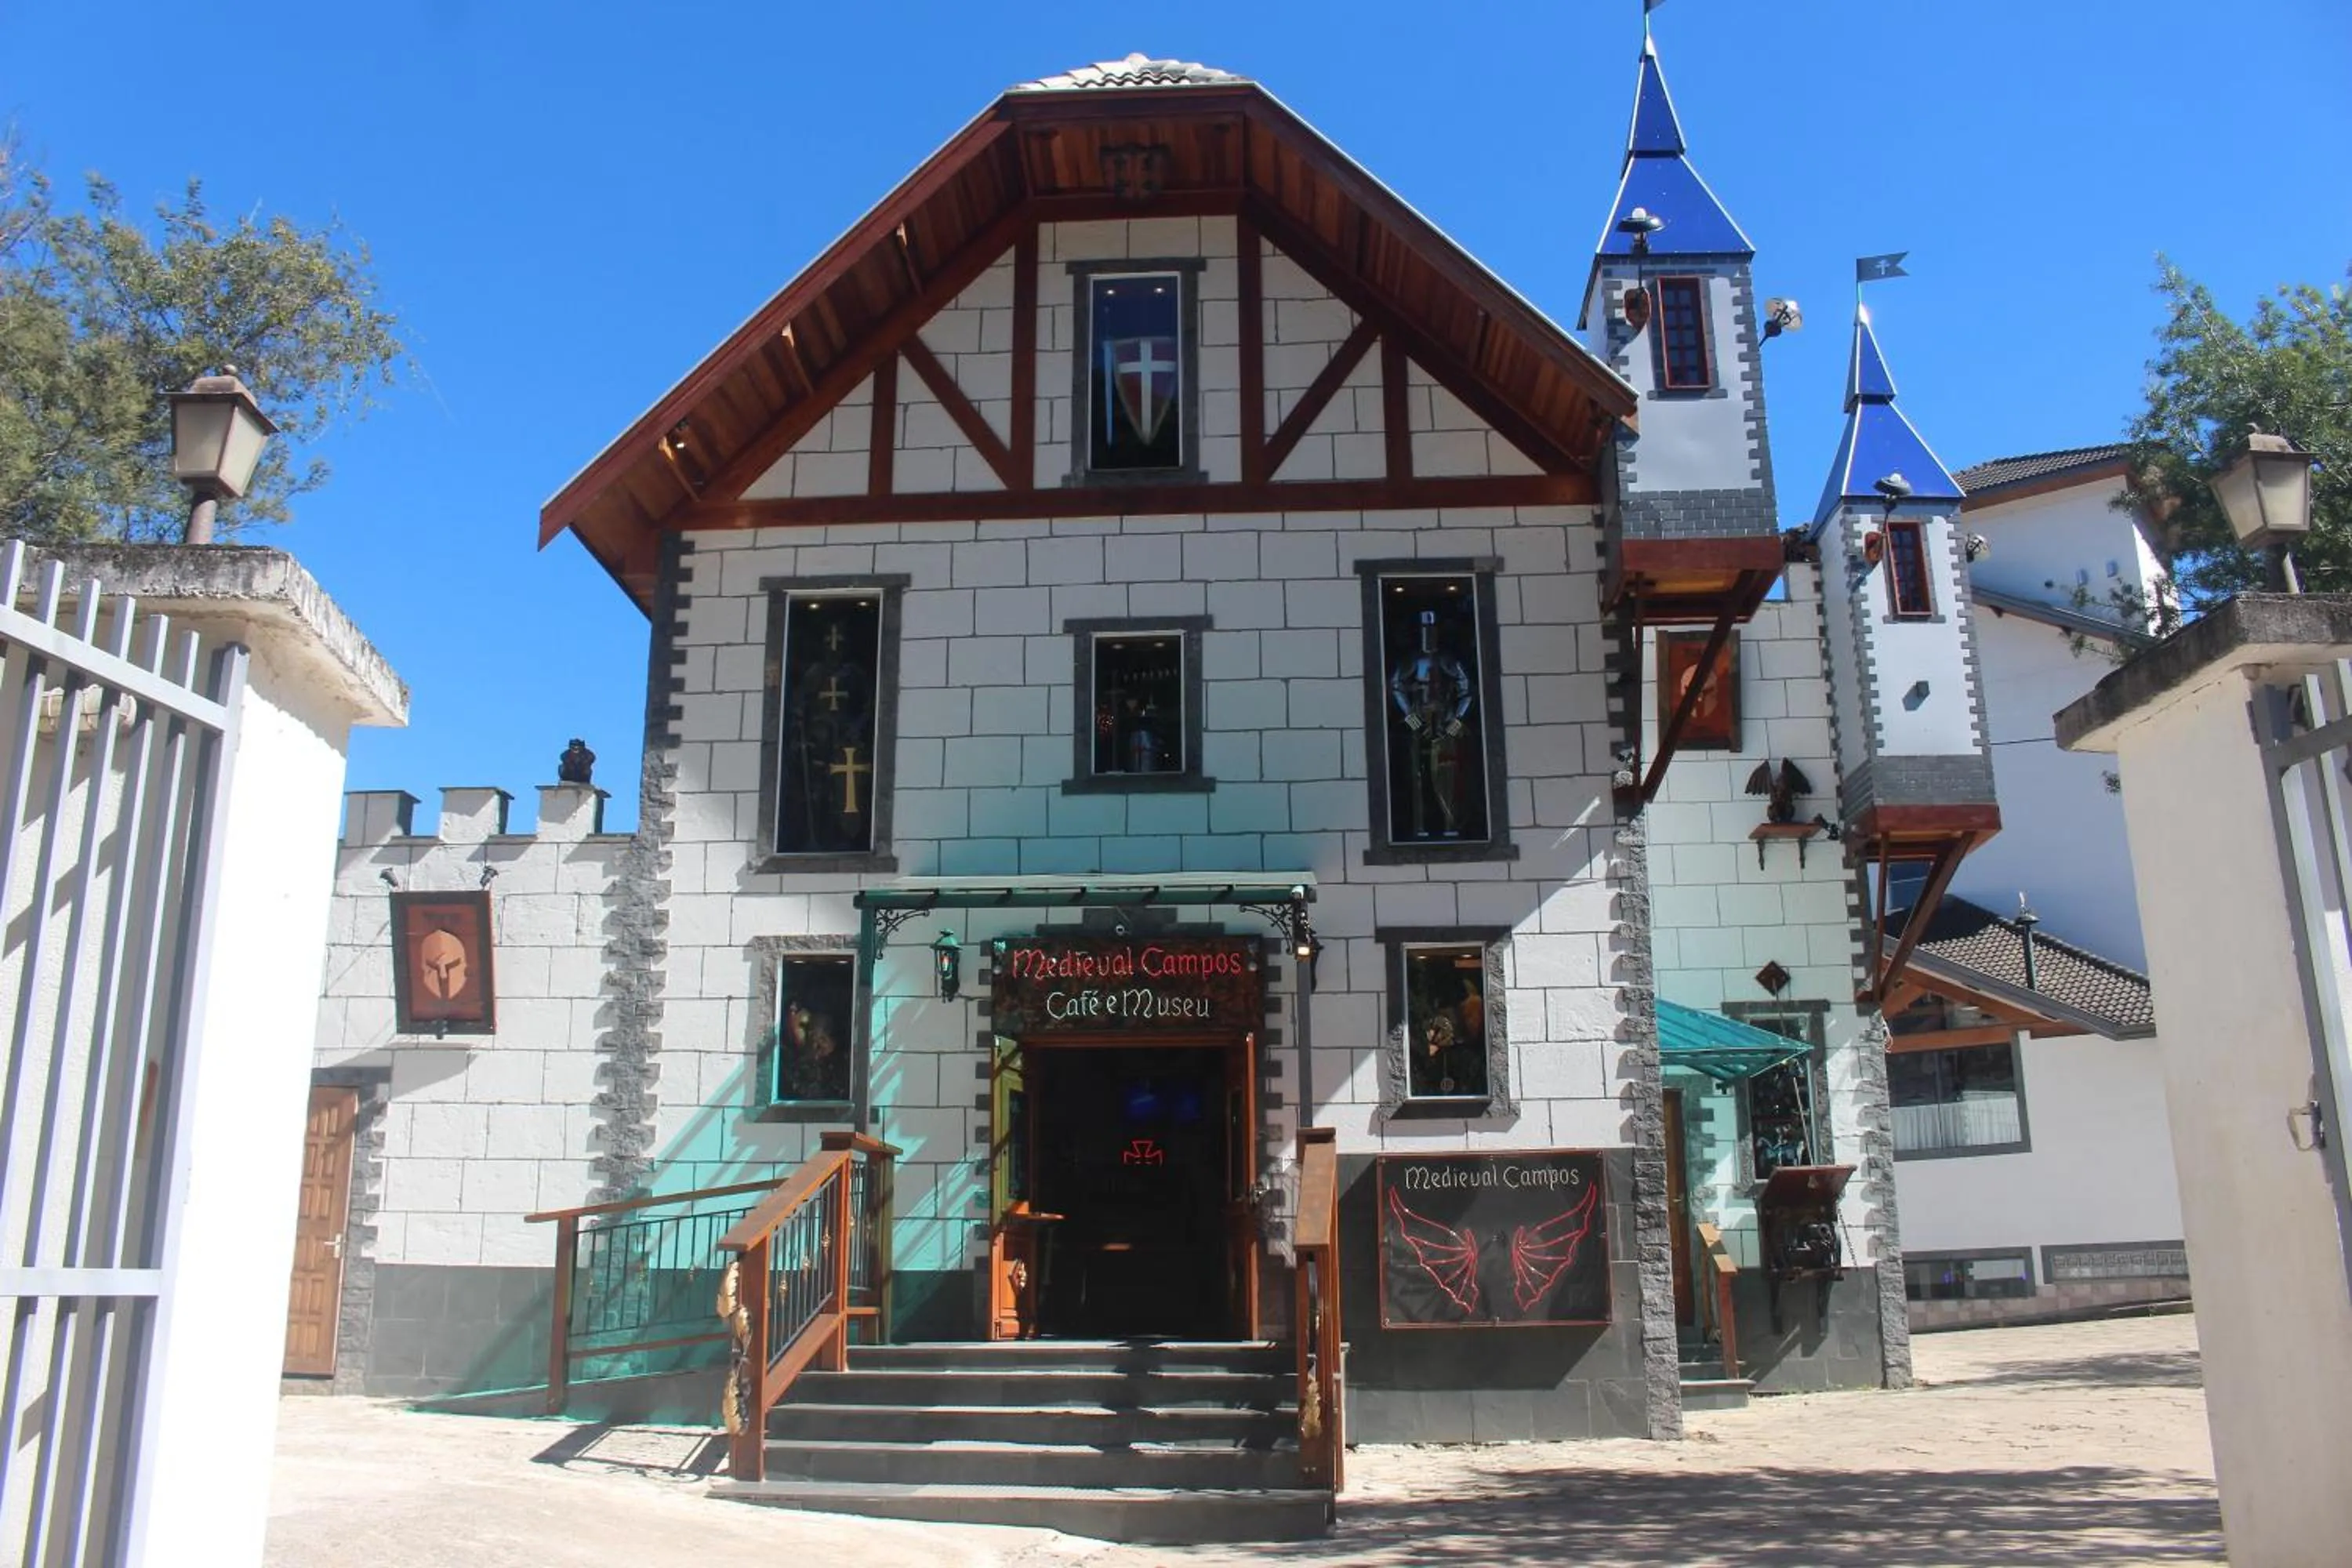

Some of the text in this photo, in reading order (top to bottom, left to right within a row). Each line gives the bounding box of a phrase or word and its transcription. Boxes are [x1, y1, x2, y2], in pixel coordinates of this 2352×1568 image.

[1012, 946, 1241, 980] Medieval Campos
[1047, 989, 1210, 1020] Café e Museu
[1405, 1164, 1580, 1190] Medieval Campos
